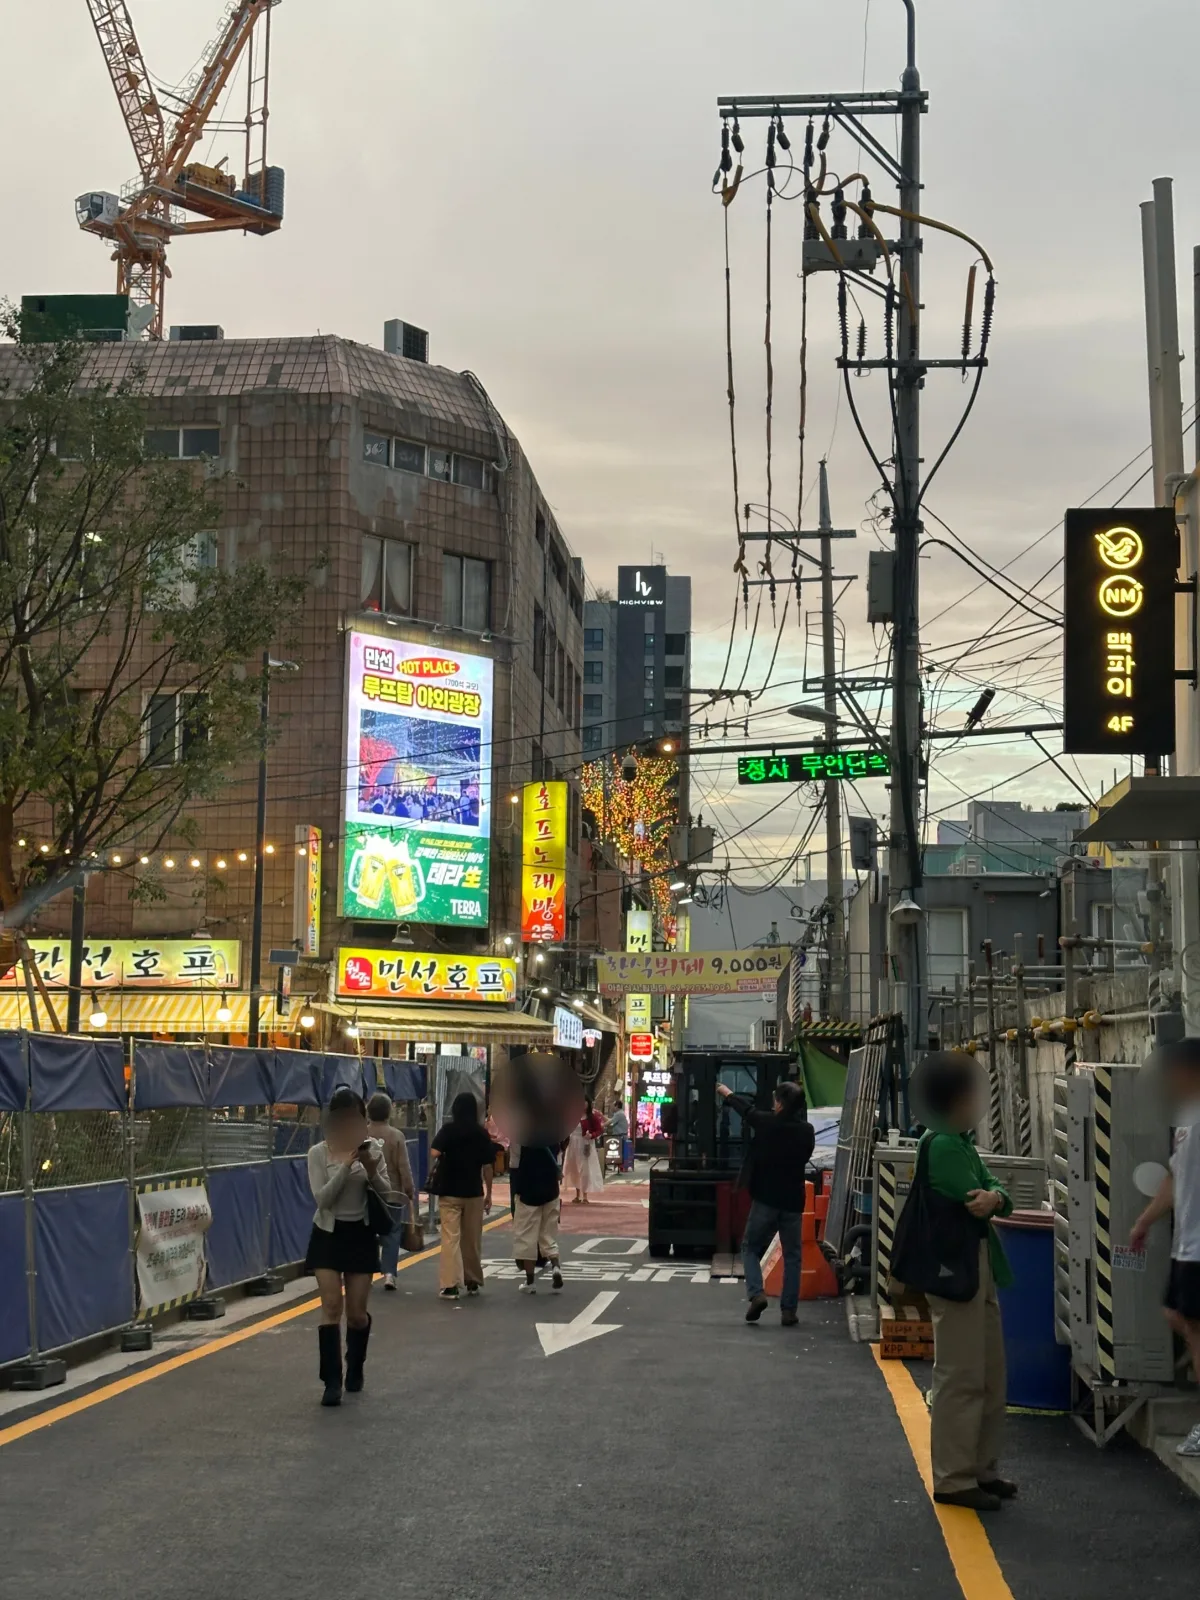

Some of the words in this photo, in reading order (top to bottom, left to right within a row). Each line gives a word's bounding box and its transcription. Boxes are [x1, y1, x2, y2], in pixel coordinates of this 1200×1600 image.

[1106, 588, 1136, 604] NM
[365, 647, 393, 673] 만선
[399, 660, 420, 674] HOT
[423, 661, 456, 675] PLACE
[1107, 632, 1136, 698] 맥파이
[363, 674, 414, 706] 루프탑
[416, 685, 481, 716] 야외광장
[1107, 715, 1134, 732] 4F
[531, 787, 557, 921] 호프노래방
[450, 898, 482, 917] TERRA
[531, 923, 555, 940] 2층
[33, 946, 217, 981] 만선호프
[346, 960, 371, 987] 원조
[378, 958, 504, 993] 만선호프
